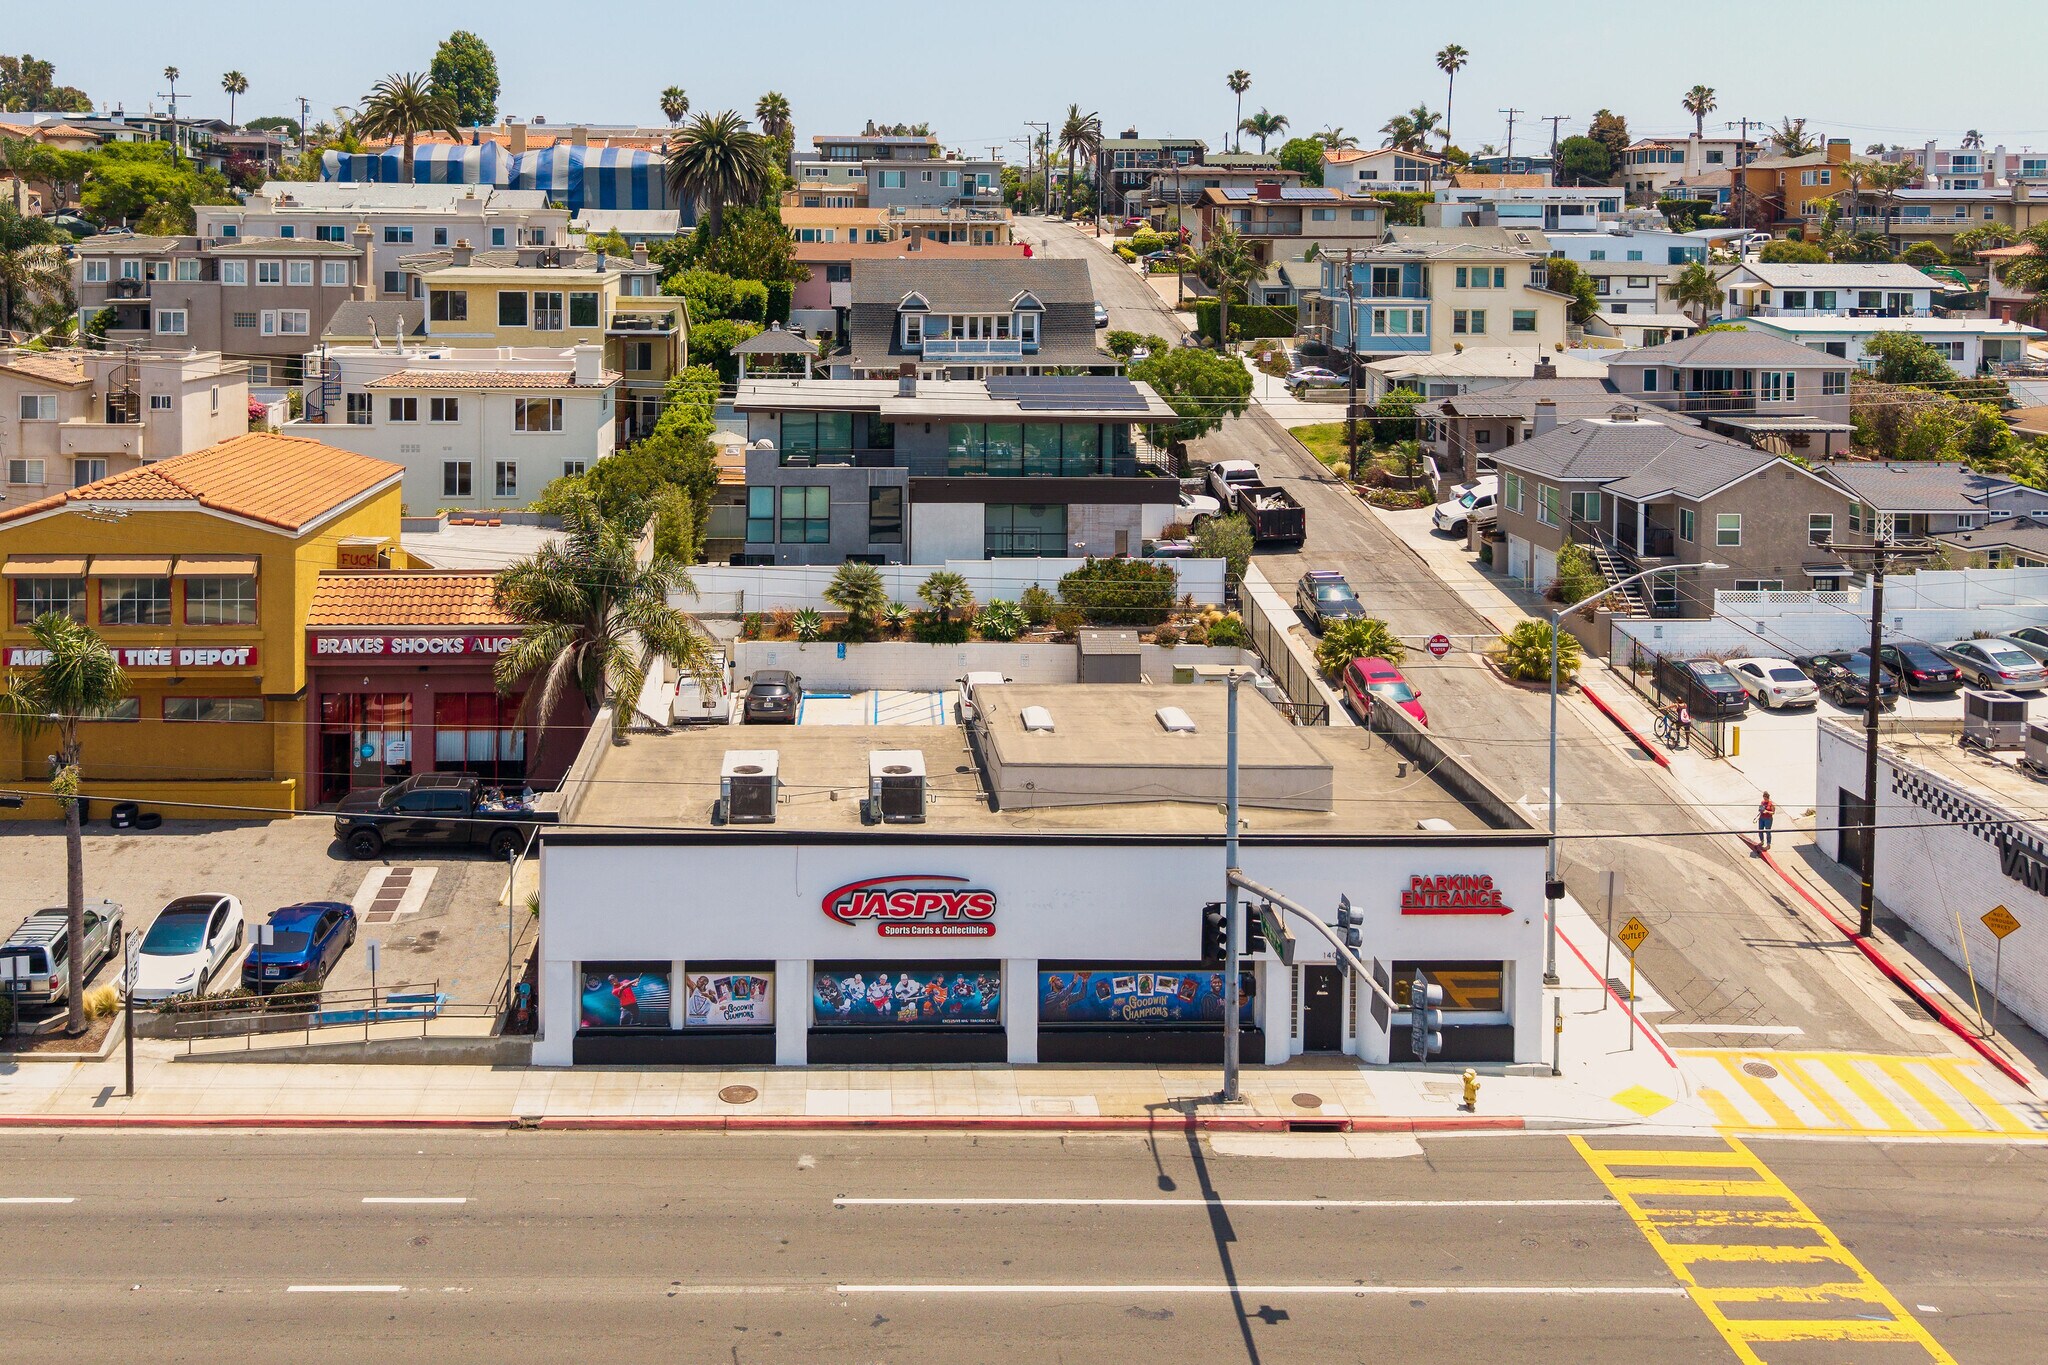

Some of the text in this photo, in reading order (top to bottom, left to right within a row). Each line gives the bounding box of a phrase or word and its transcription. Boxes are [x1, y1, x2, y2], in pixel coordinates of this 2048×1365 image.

[341, 553, 377, 566] FUCK
[316, 637, 384, 654] BRAKES
[390, 637, 464, 654] SHOCKS
[125, 649, 171, 666] TIRE
[179, 649, 250, 666] DEPOT
[1410, 875, 1493, 890] PARKING
[838, 889, 997, 920] JASPYS
[1401, 890, 1502, 906] ENTRANCE
[885, 926, 988, 935] Sports Cards & Collectibles
[1628, 923, 1639, 931] NO
[1621, 931, 1646, 941] OUTLET
[129, 960, 138, 986] 35
[728, 1003, 755, 1013] GOODWIN
[1129, 995, 1169, 1009] GOODWIN
[723, 1010, 755, 1021] CHAMPIONS
[1122, 1004, 1169, 1020] CHAMPIONS
